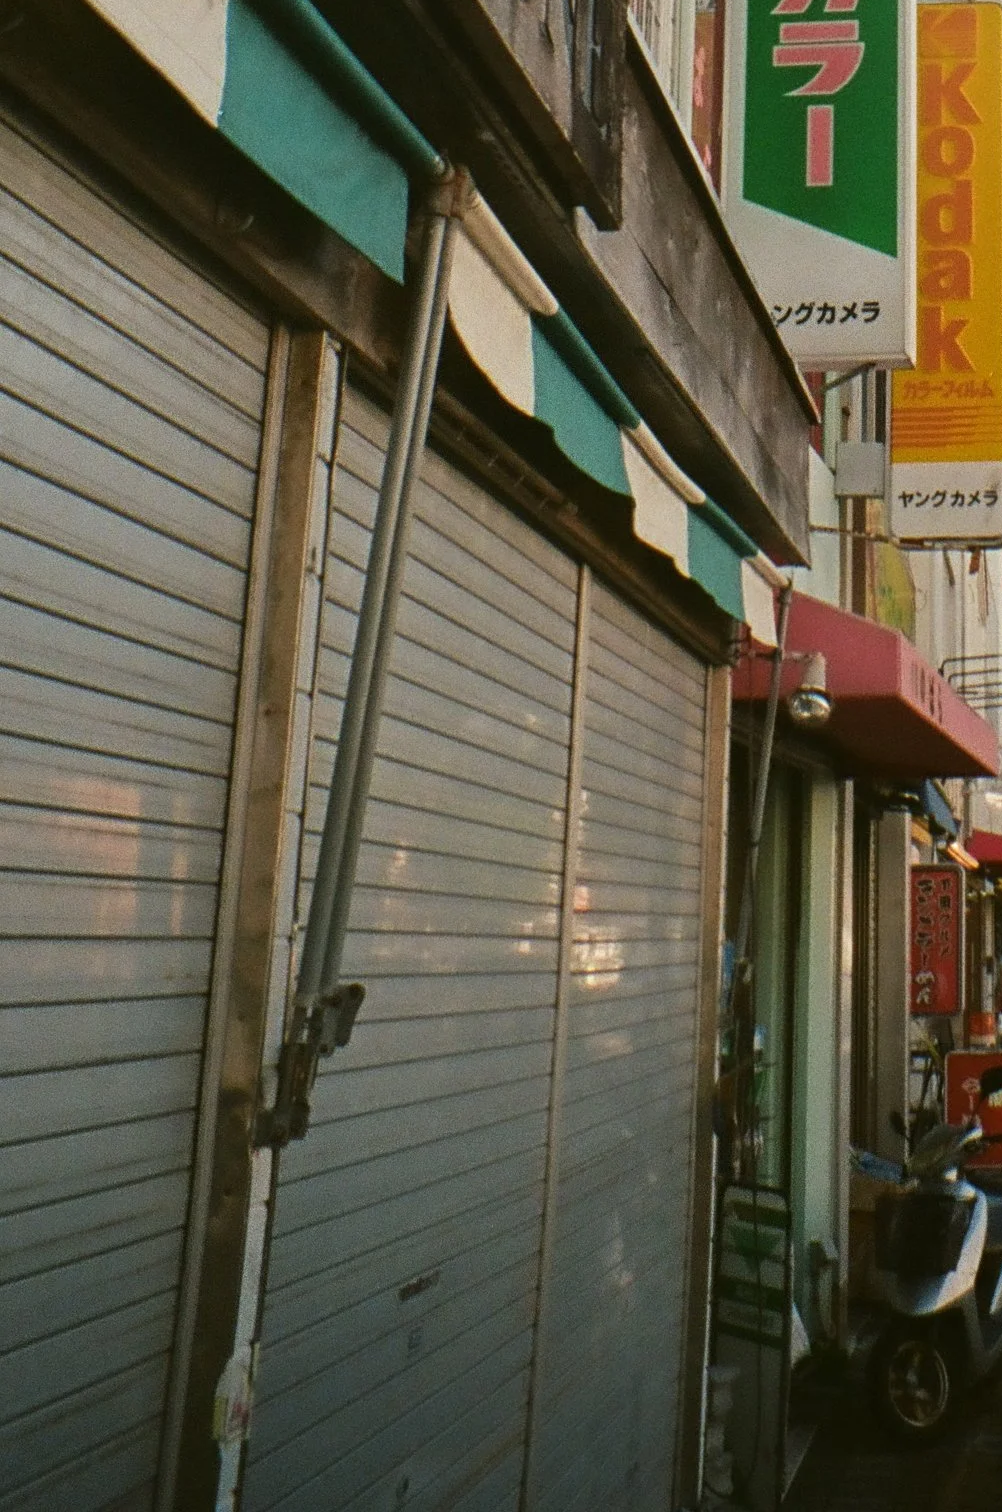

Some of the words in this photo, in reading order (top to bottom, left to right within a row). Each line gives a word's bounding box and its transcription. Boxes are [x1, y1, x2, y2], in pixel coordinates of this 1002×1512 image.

[919, 62, 983, 373] Kodak
[771, 300, 881, 327] ングカメラ
[903, 379, 994, 399] カラーフィルム
[898, 490, 999, 508] ヤングカメラ
